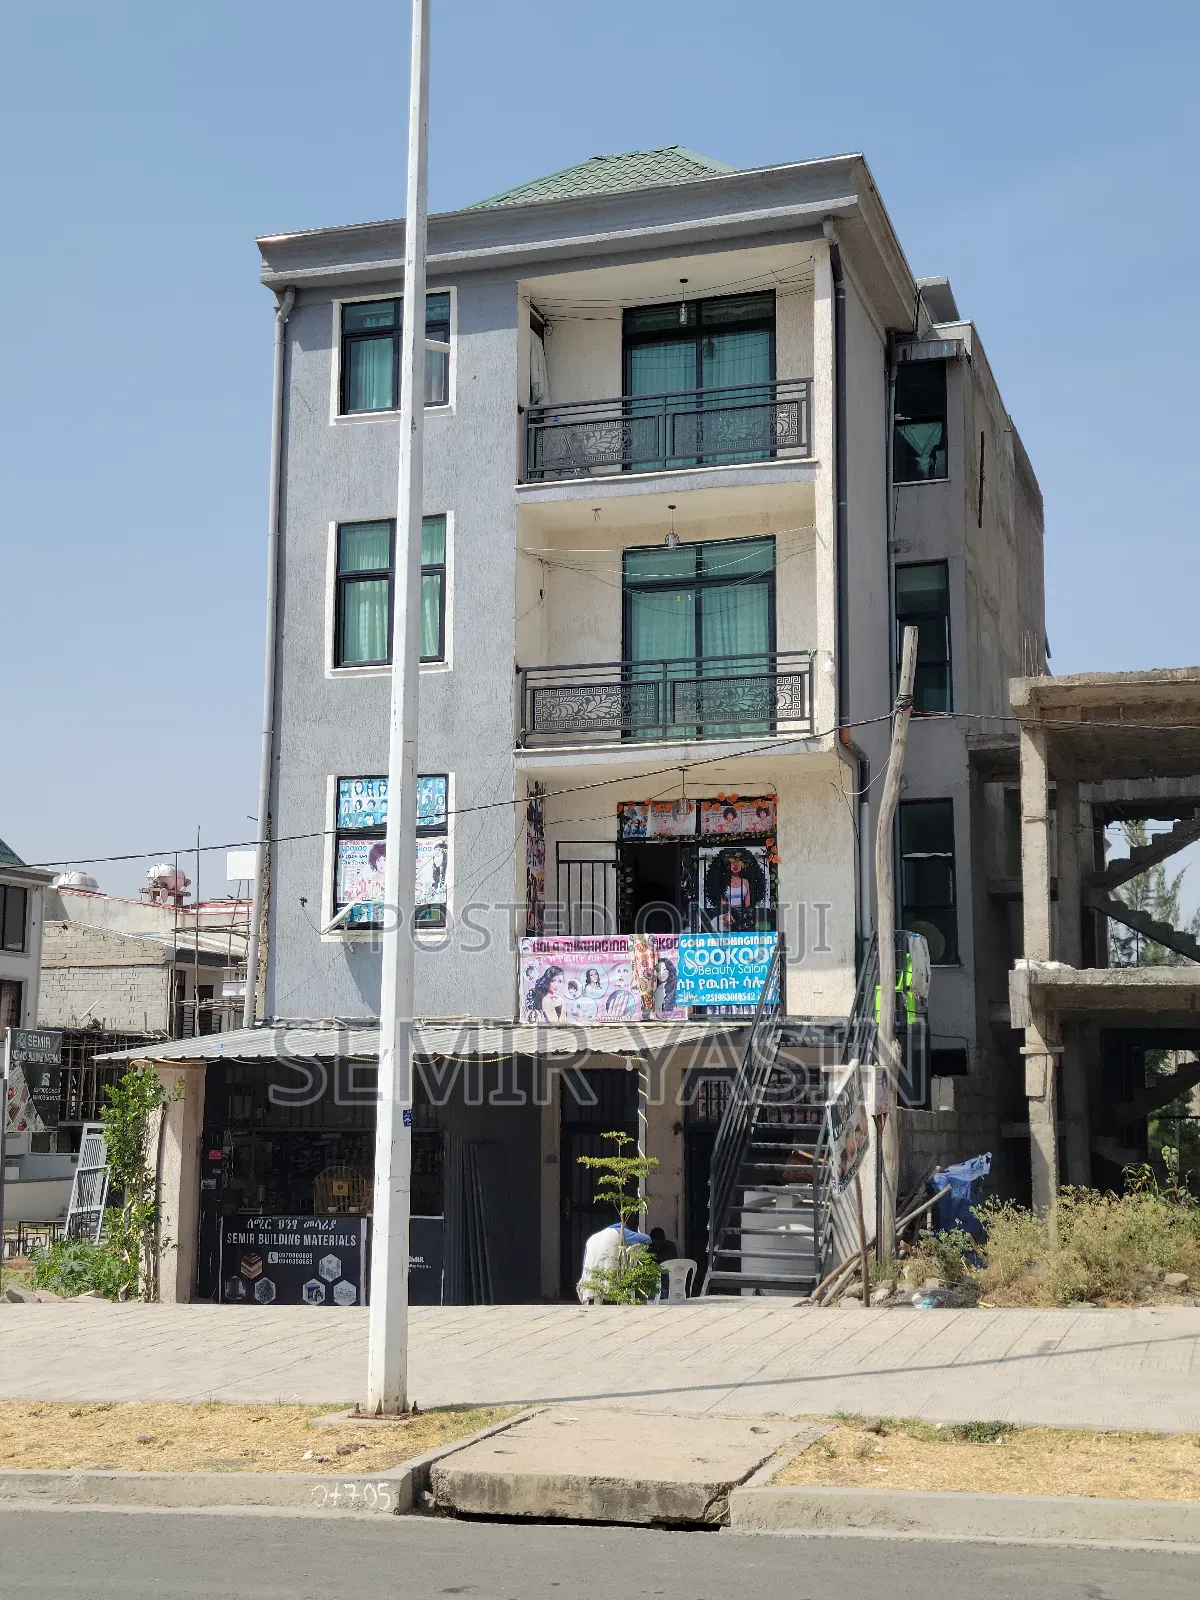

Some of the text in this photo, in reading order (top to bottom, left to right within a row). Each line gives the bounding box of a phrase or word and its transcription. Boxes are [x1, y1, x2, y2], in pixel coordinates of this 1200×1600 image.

[680, 938, 705, 948] GOLA
[698, 963, 768, 976] Beauty Salon
[743, 975, 766, 988] ሳሎ
[28, 1034, 51, 1049] SEMIR
[226, 1232, 357, 1247] SEMIR BUILDING MATERIALS
